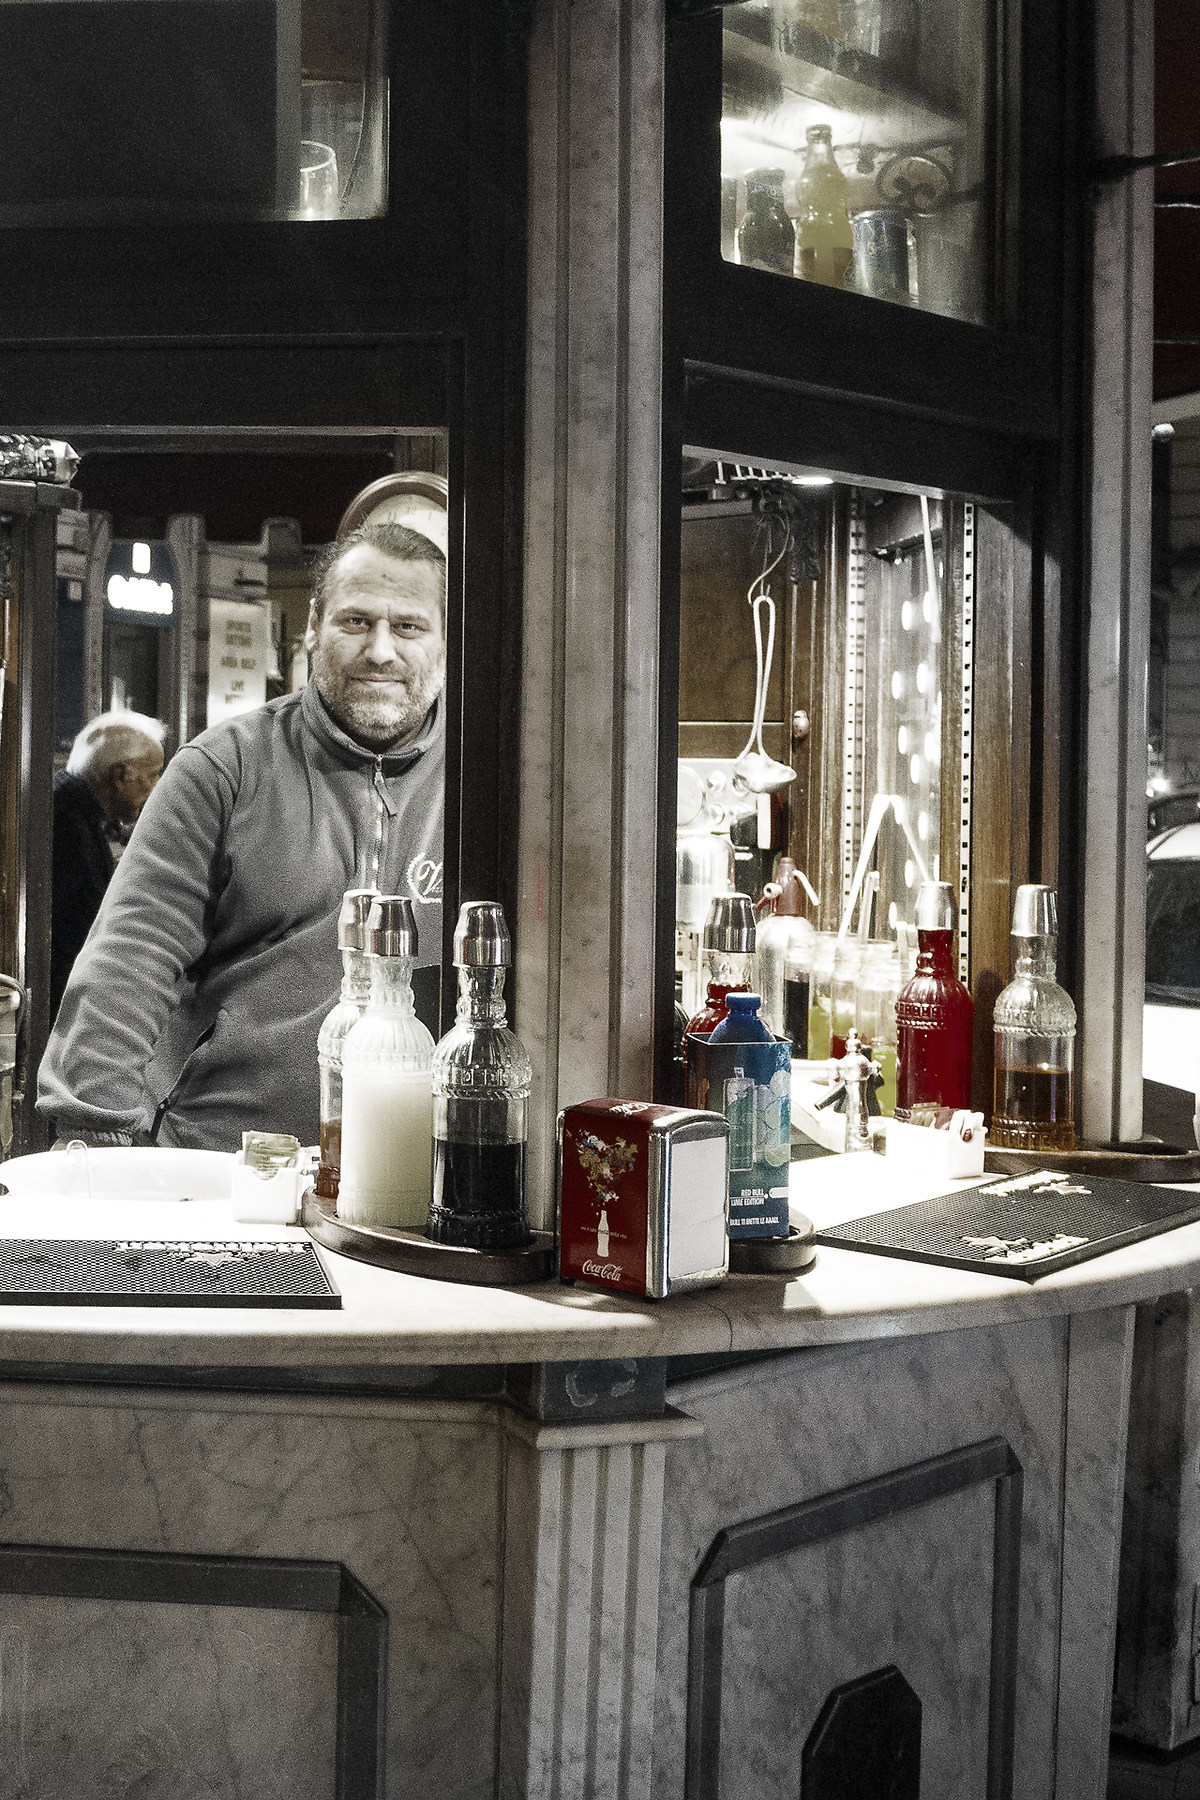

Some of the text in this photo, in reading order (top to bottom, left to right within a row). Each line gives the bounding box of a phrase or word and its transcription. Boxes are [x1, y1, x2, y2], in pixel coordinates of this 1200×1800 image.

[752, 1188, 764, 1196] BULL
[744, 1198, 765, 1206] EDITION
[582, 1259, 623, 1282] Coca-Cola
